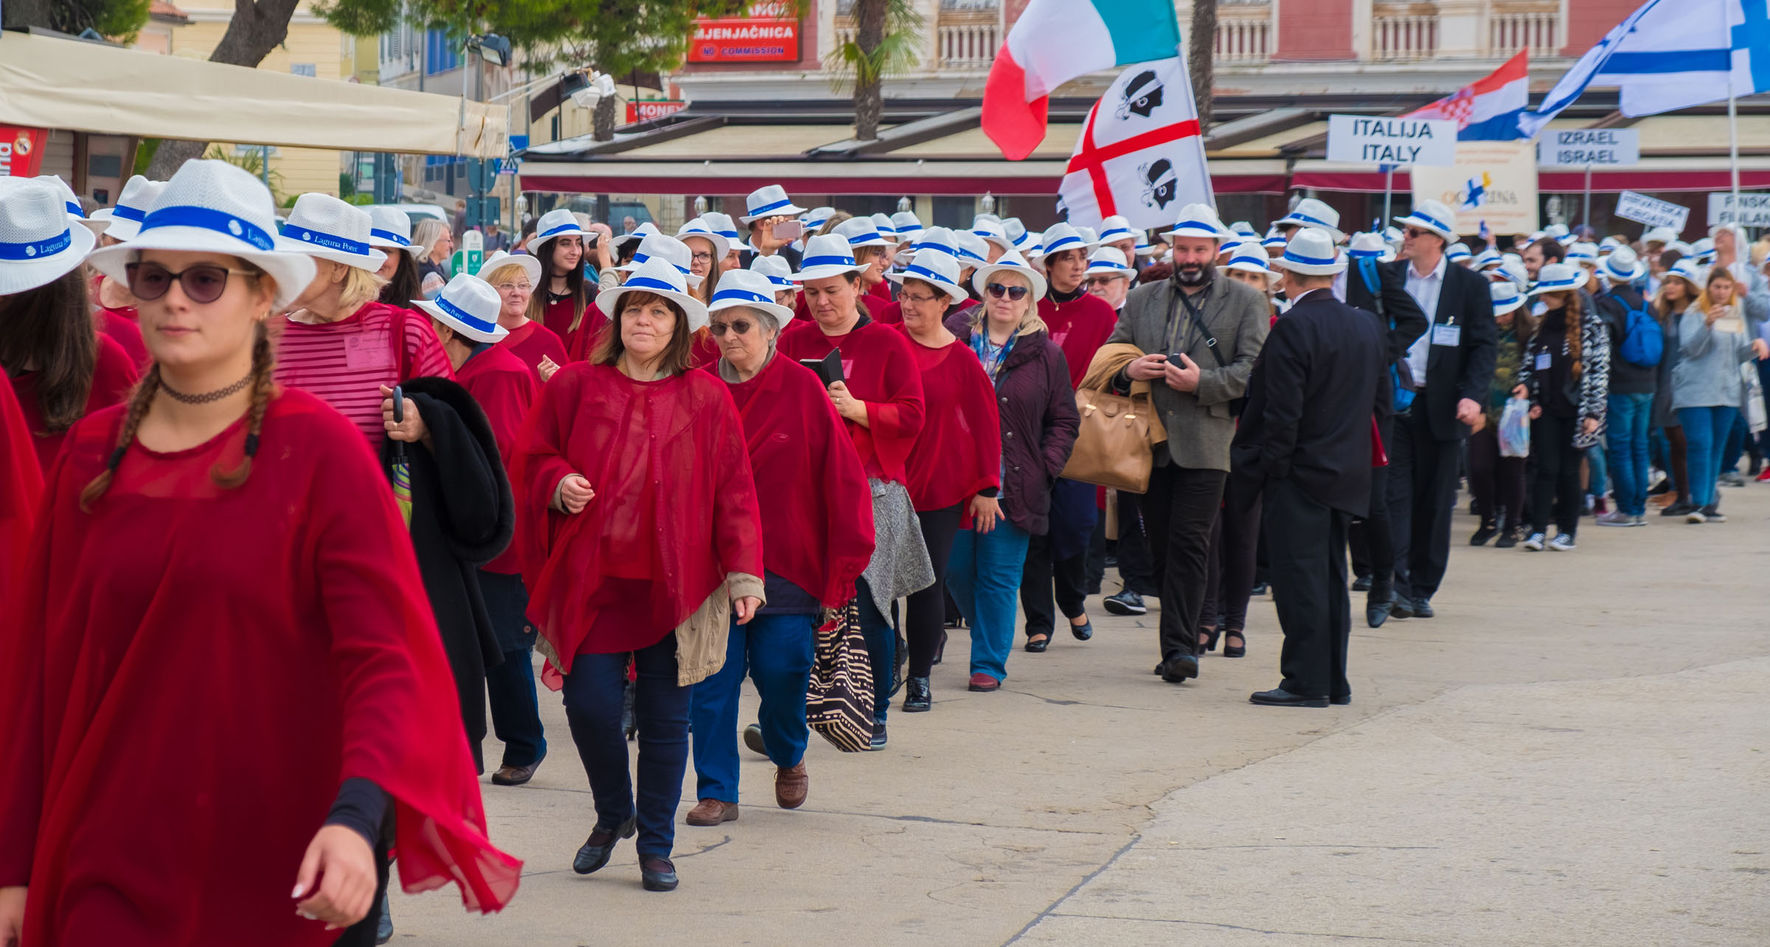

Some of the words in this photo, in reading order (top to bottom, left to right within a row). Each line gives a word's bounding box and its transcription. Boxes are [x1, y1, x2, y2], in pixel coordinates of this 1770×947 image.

[693, 26, 794, 40] MJENJAČNICA
[703, 47, 715, 56] NO
[721, 46, 785, 56] COMMISSION
[1352, 119, 1433, 139] ITALIJA
[1557, 131, 1620, 146] IZRAEL
[1361, 143, 1422, 162] ITALY
[1557, 150, 1620, 164] ISRAEL
[40, 241, 64, 255] Laguna
[314, 235, 341, 248] Laguna
